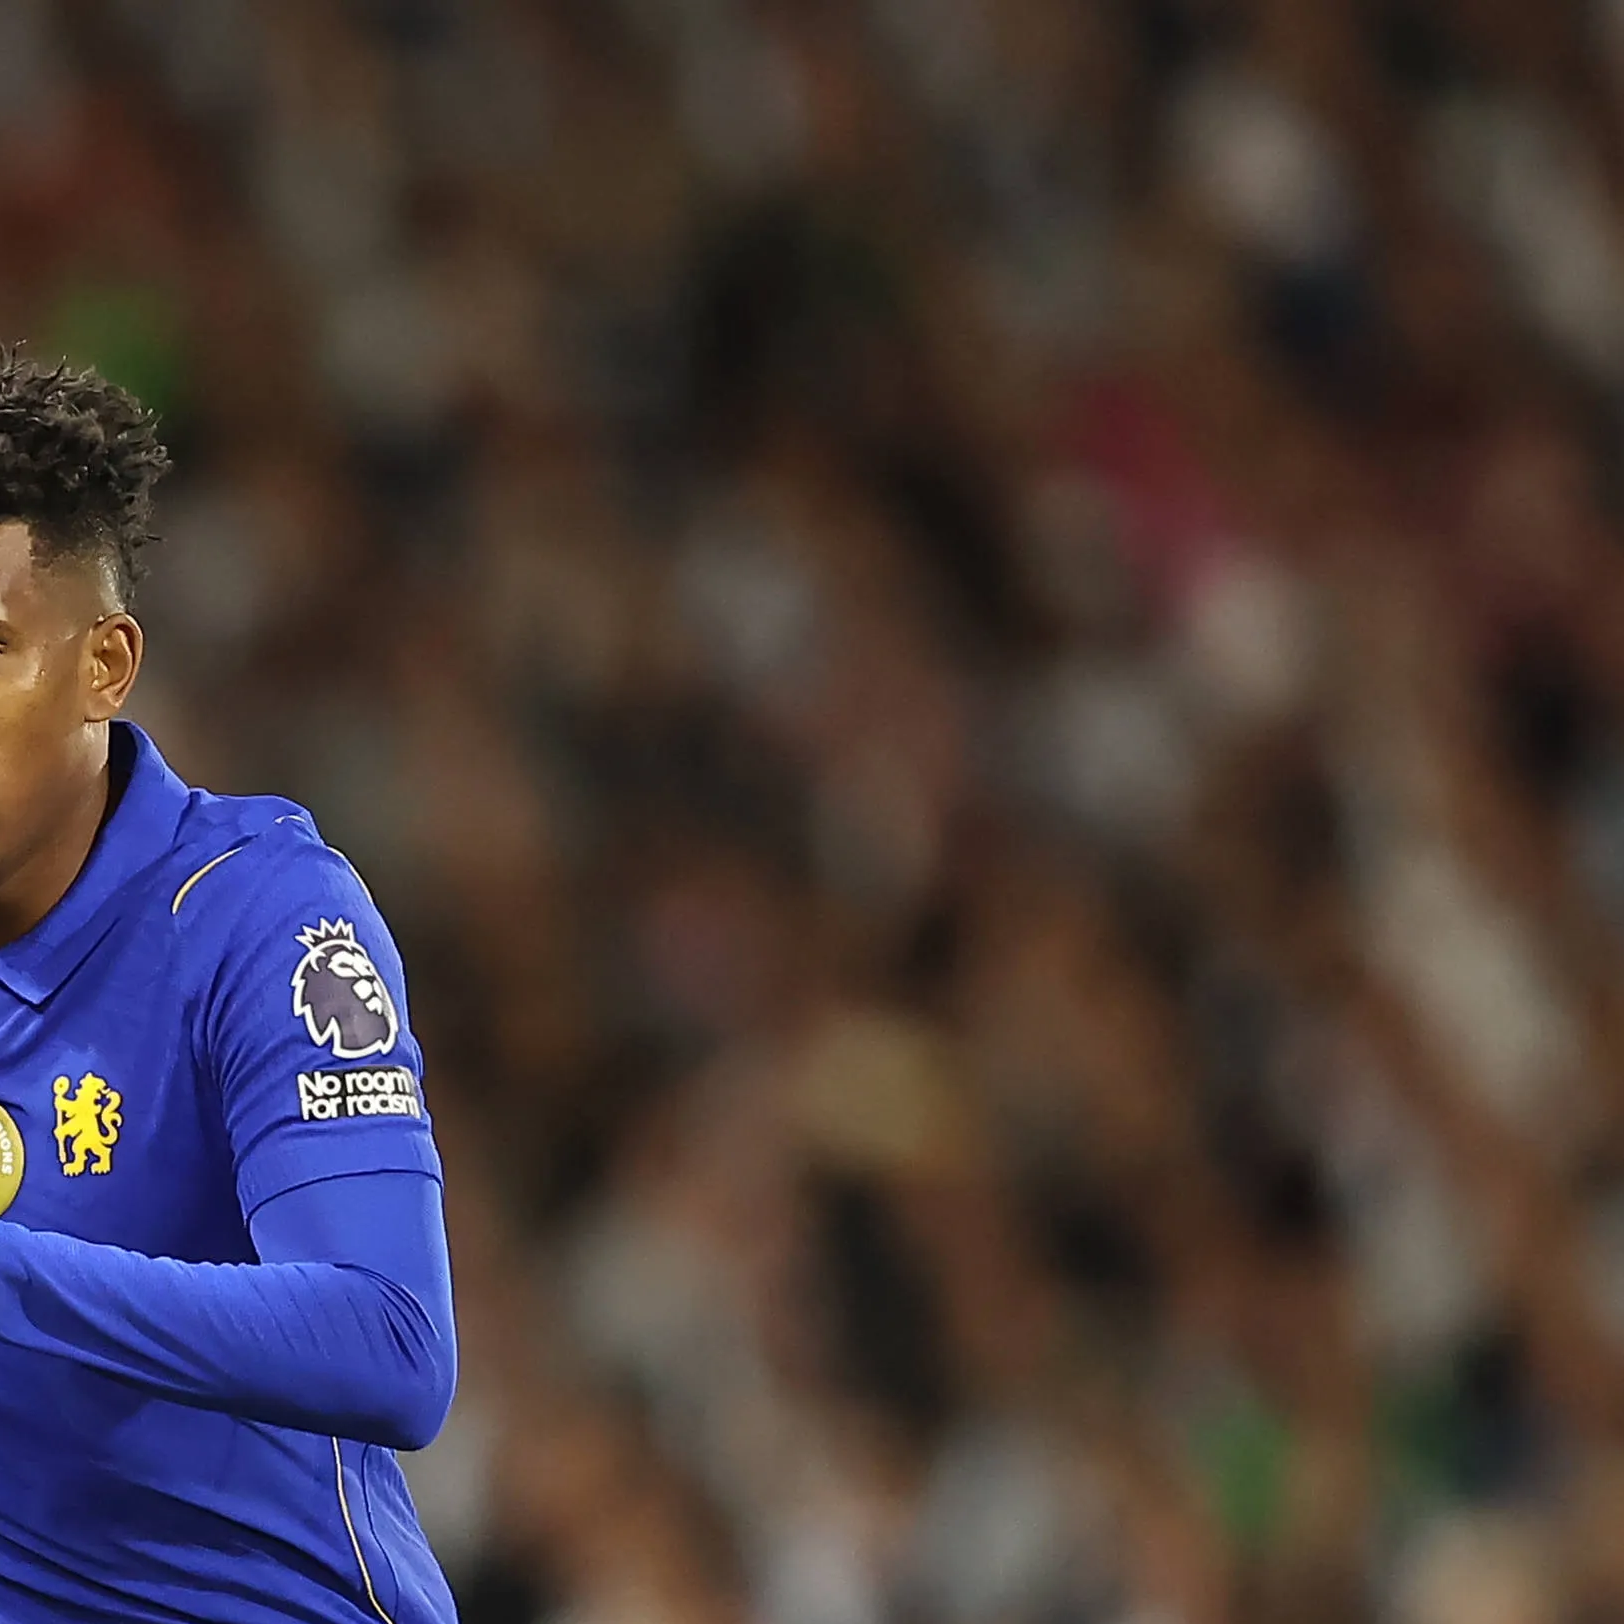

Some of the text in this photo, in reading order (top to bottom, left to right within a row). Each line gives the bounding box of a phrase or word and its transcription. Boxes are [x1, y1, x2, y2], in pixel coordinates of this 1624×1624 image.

[297, 1071, 410, 1098] No room
[346, 1094, 421, 1119] racism
